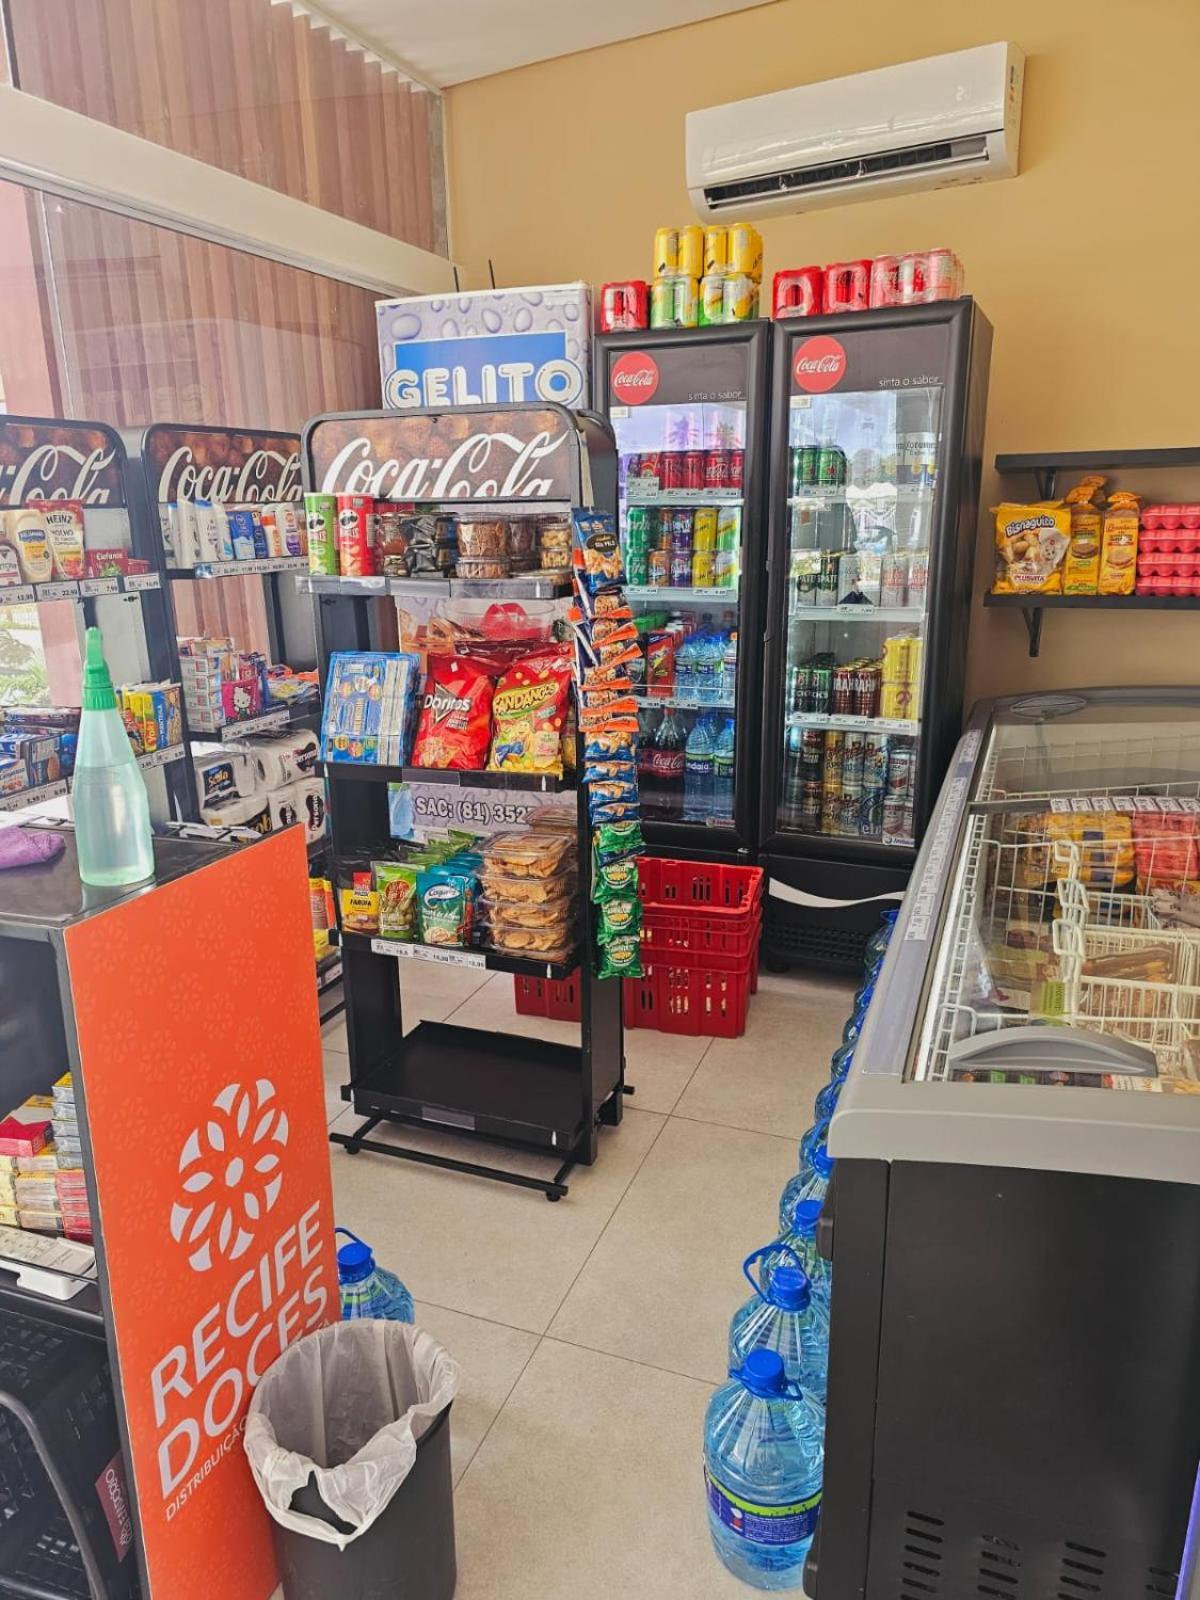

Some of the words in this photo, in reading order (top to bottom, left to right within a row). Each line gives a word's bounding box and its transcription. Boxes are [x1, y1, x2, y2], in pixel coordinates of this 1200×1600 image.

[797, 355, 841, 374] Coca-Cola
[384, 359, 583, 409] GELITO
[615, 369, 654, 388] Coca-Cola
[322, 430, 570, 497] Coca-Cola
[46, 514, 73, 524] HEINZ
[1006, 515, 1055, 536] Bisnaguito
[424, 695, 470, 711] Doritos
[653, 753, 682, 769] Coca-Co
[416, 796, 453, 818] SAC:
[457, 801, 491, 825] (81)
[151, 1200, 321, 1428] RECIFE
[158, 1265, 327, 1499] DOCES
[165, 1415, 248, 1522] DISTRIBUIÇÃO
